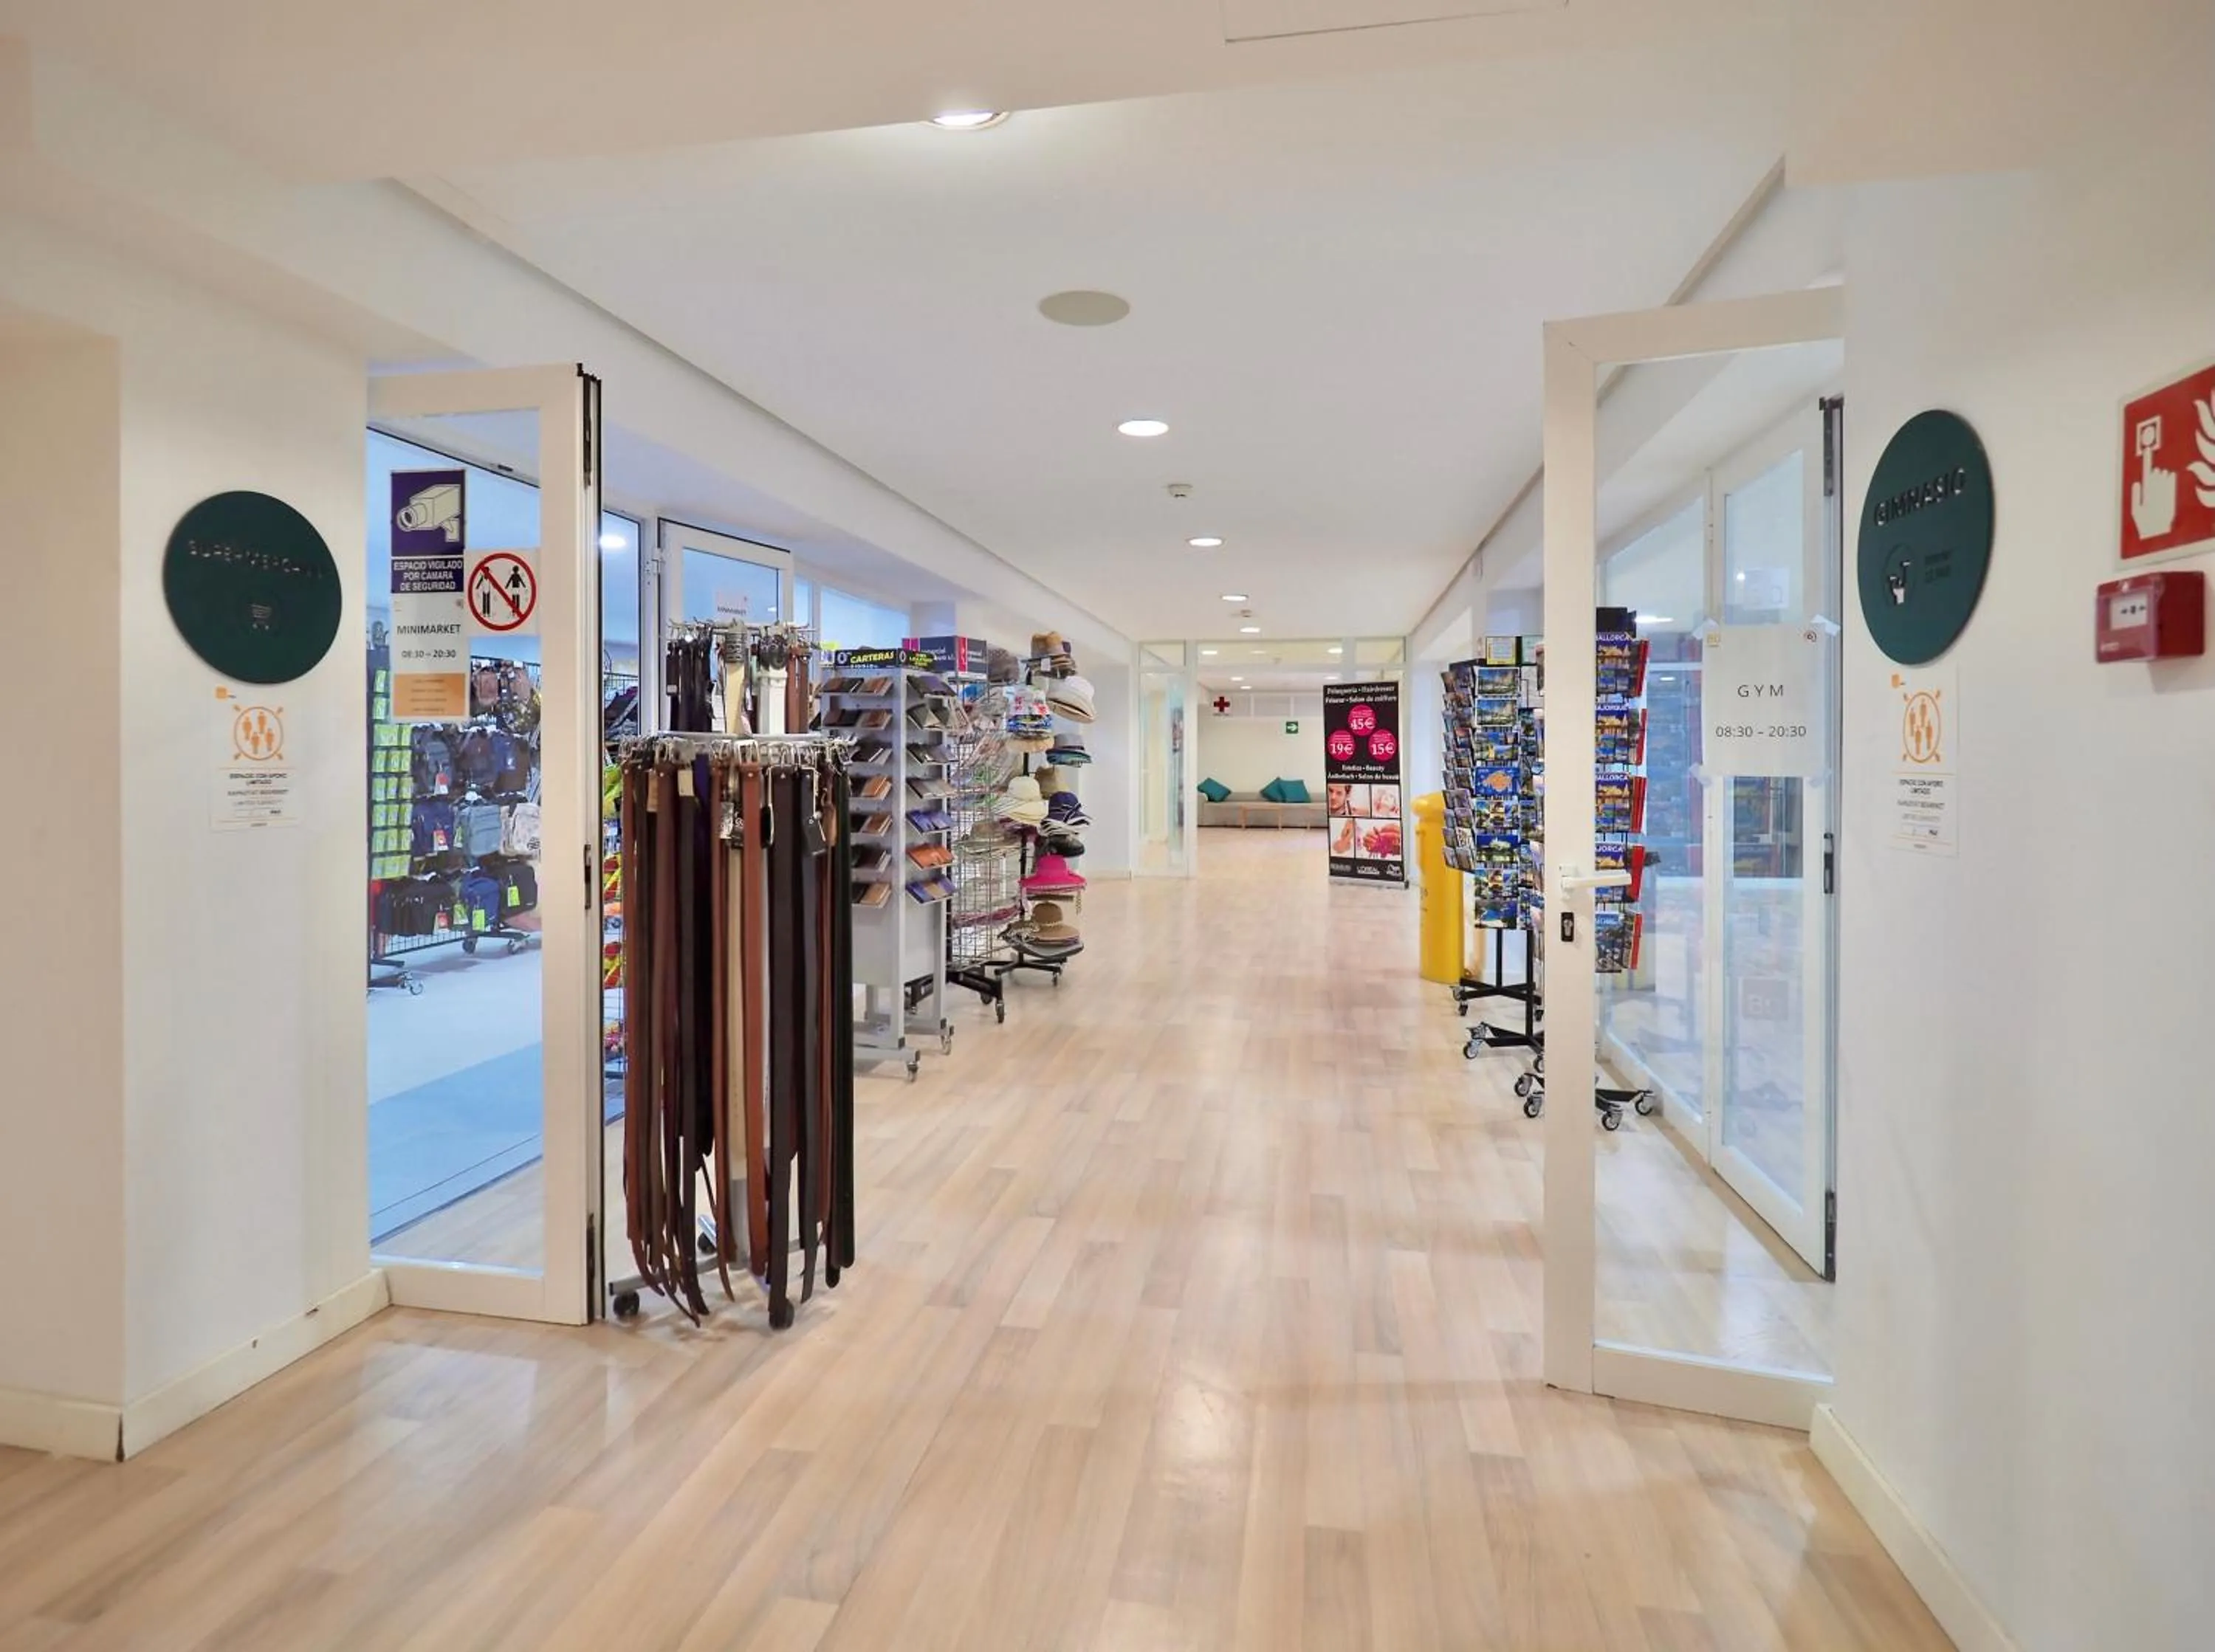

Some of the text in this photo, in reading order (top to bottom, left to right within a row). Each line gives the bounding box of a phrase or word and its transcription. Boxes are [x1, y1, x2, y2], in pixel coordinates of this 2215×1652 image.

[394, 560, 462, 571] ESPACIO VIGILADO
[403, 571, 453, 581] POR CAMARA
[399, 581, 456, 591] DE SEGURIDAD
[396, 624, 461, 635] MINIMARKET
[1596, 633, 1629, 641] ALLORCA
[433, 650, 456, 658] 20:30
[850, 650, 894, 664] CARTERAS
[1350, 717, 1376, 730] 45€
[1715, 726, 1754, 737] 08:30
[1768, 726, 1807, 737] 20:30
[1330, 743, 1353, 755] 19€
[1371, 743, 1395, 755] 15€
